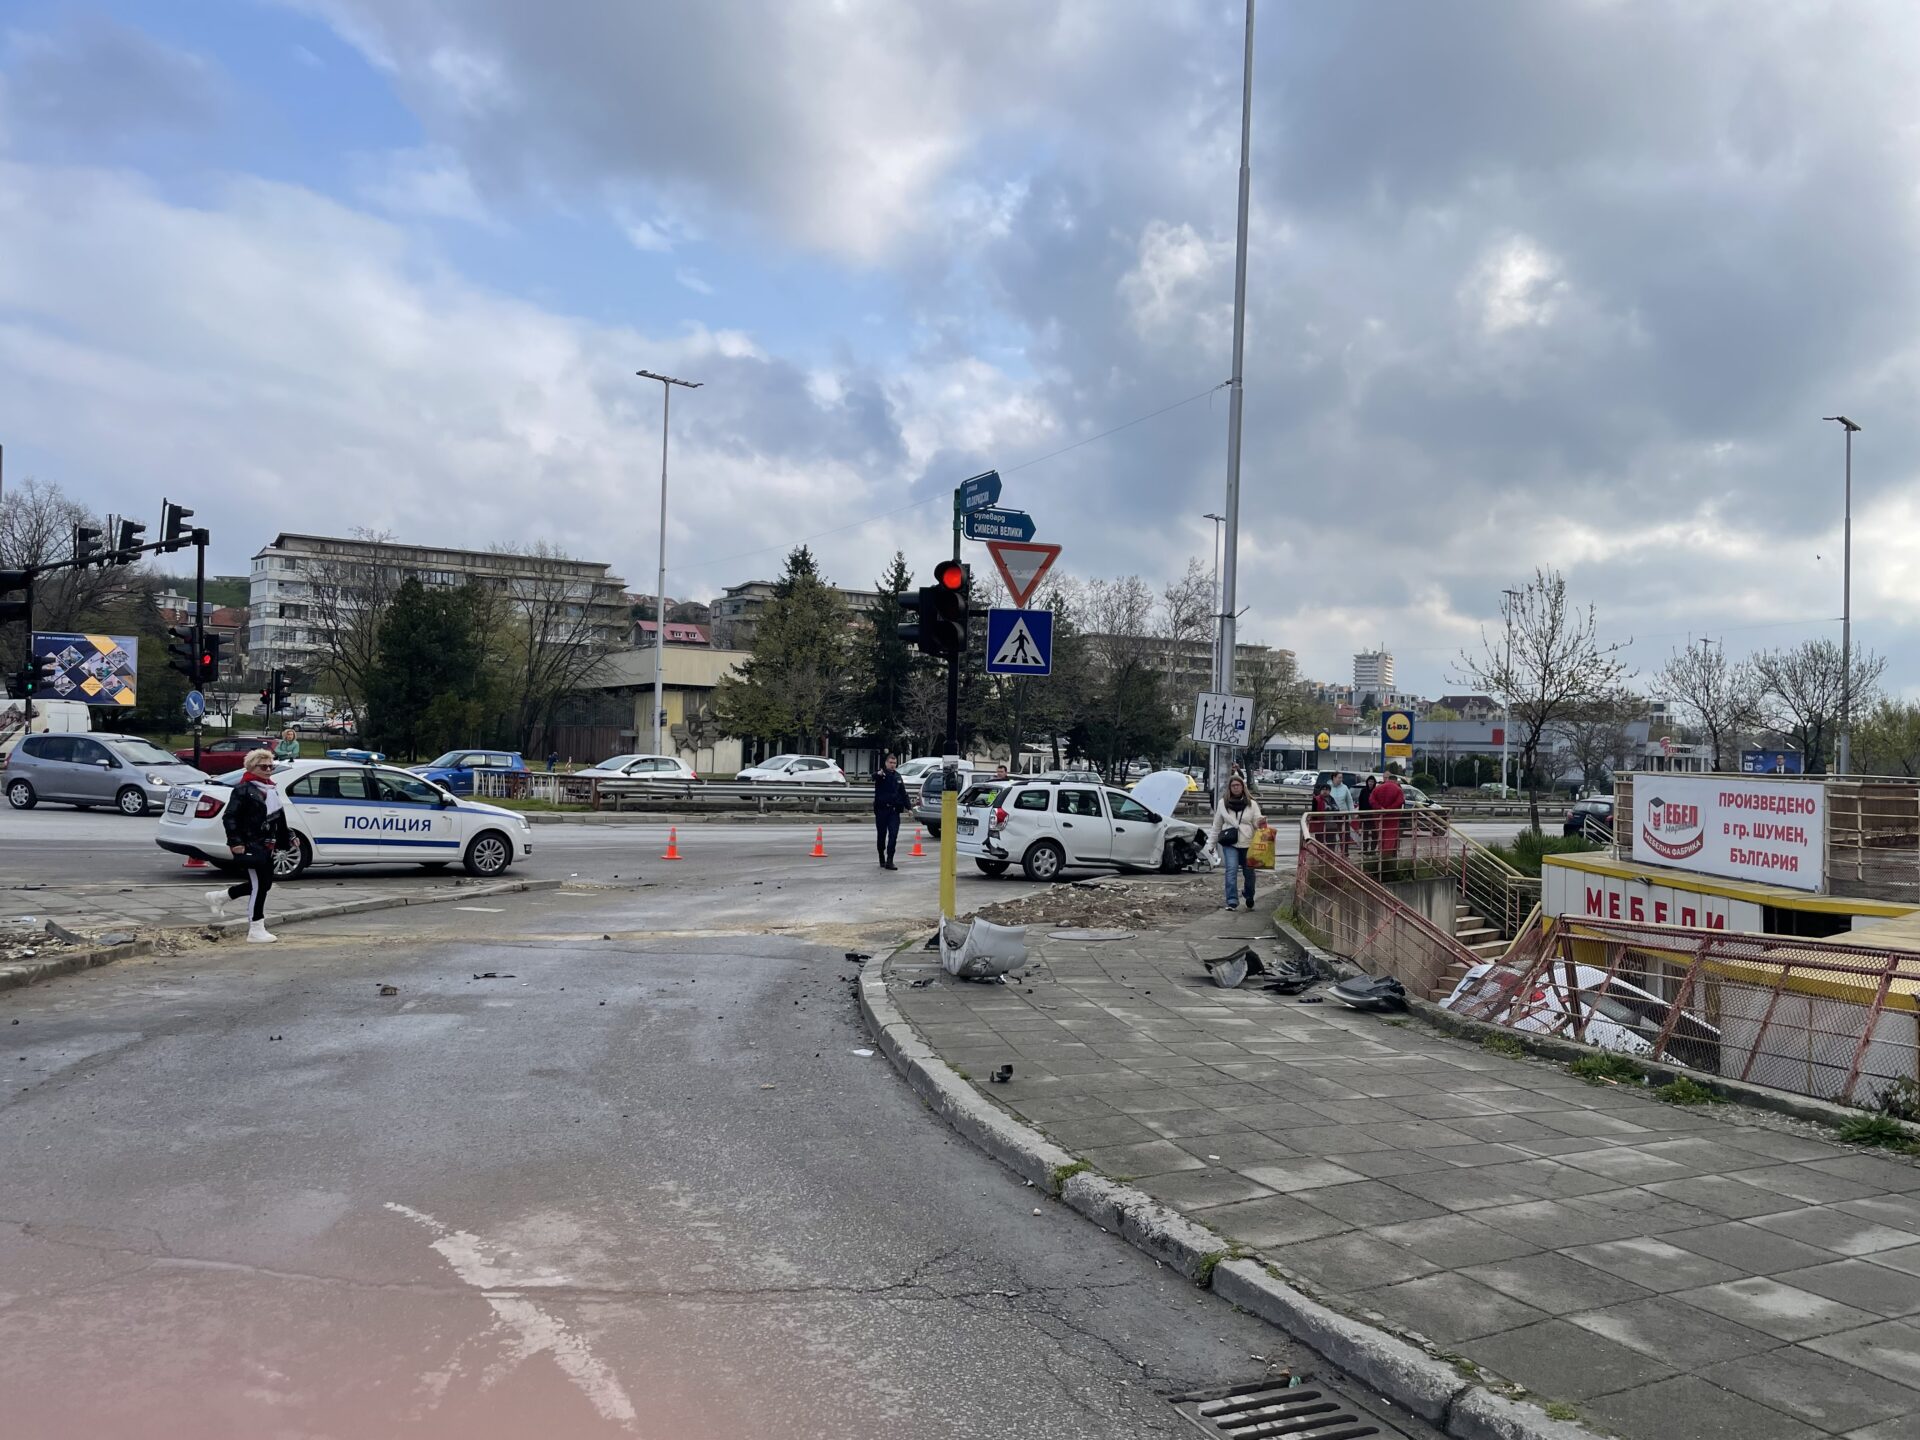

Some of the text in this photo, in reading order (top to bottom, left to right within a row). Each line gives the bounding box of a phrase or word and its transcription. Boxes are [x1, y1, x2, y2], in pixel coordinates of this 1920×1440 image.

[973, 523, 1023, 538] СИМЕОН ВЕЛИКИ
[1719, 792, 1816, 815] ПРОИЗВЕДЕНО
[344, 815, 432, 832] ПОЛИЦИЯ
[1733, 824, 1750, 840] гр.
[1753, 823, 1808, 847] ШУМЕН,
[1644, 831, 1702, 856] МЕБЕЛНА ФАБРИКА
[1730, 848, 1798, 872] БЪЛГАРИЯ
